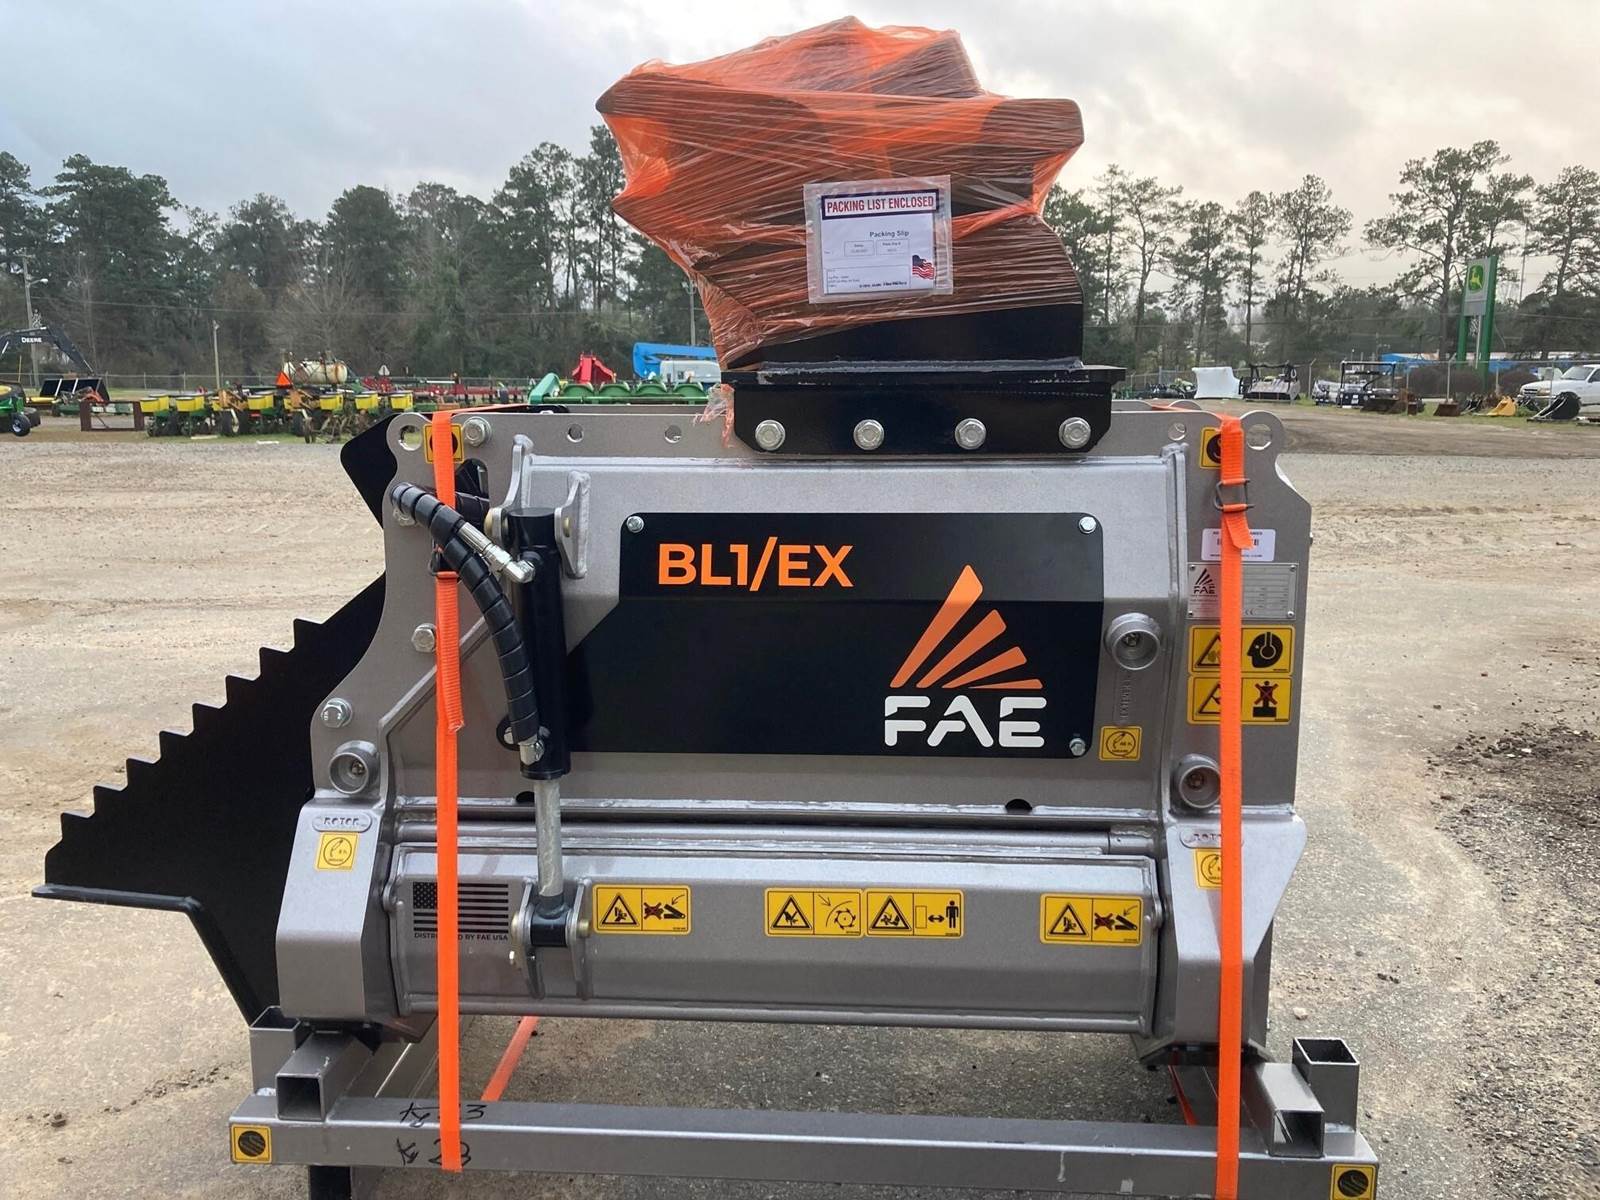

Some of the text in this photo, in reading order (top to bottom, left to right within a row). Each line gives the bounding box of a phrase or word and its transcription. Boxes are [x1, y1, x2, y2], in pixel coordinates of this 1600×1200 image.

[827, 196, 934, 213] PACKING LIST ENCLOSED
[896, 229, 910, 237] Slip
[658, 536, 854, 592] BL1/EX
[1193, 585, 1216, 595] FAE
[884, 694, 1047, 748] FAE
[464, 933, 475, 941] BY
